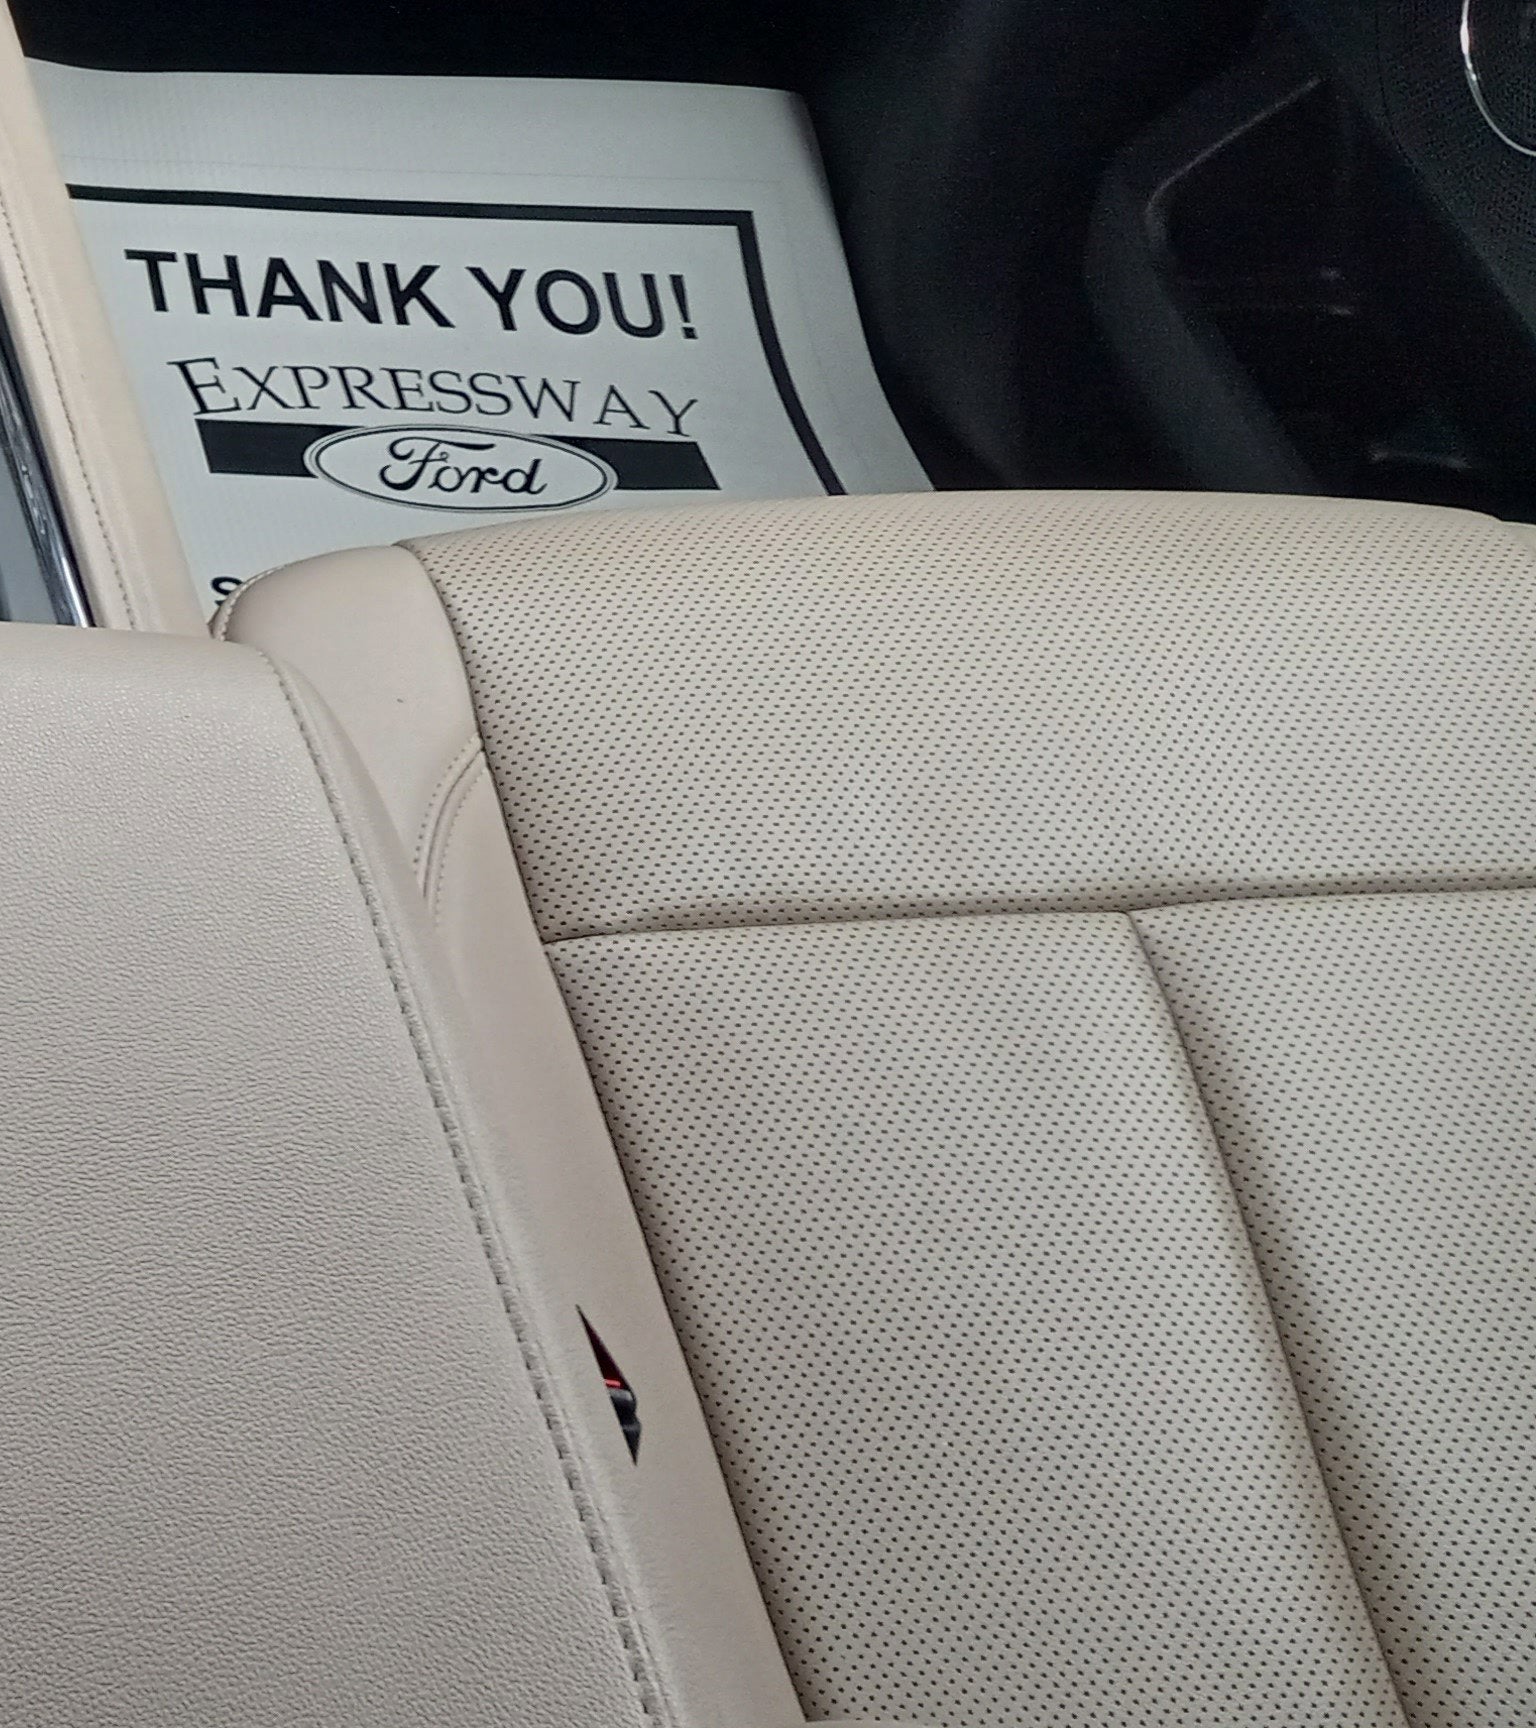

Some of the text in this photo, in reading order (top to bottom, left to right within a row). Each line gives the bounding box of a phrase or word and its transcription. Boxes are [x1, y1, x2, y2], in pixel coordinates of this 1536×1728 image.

[124, 248, 698, 341] THANK YOU!
[167, 356, 700, 438] EXPRESSWAY
[377, 434, 548, 498] Ford
